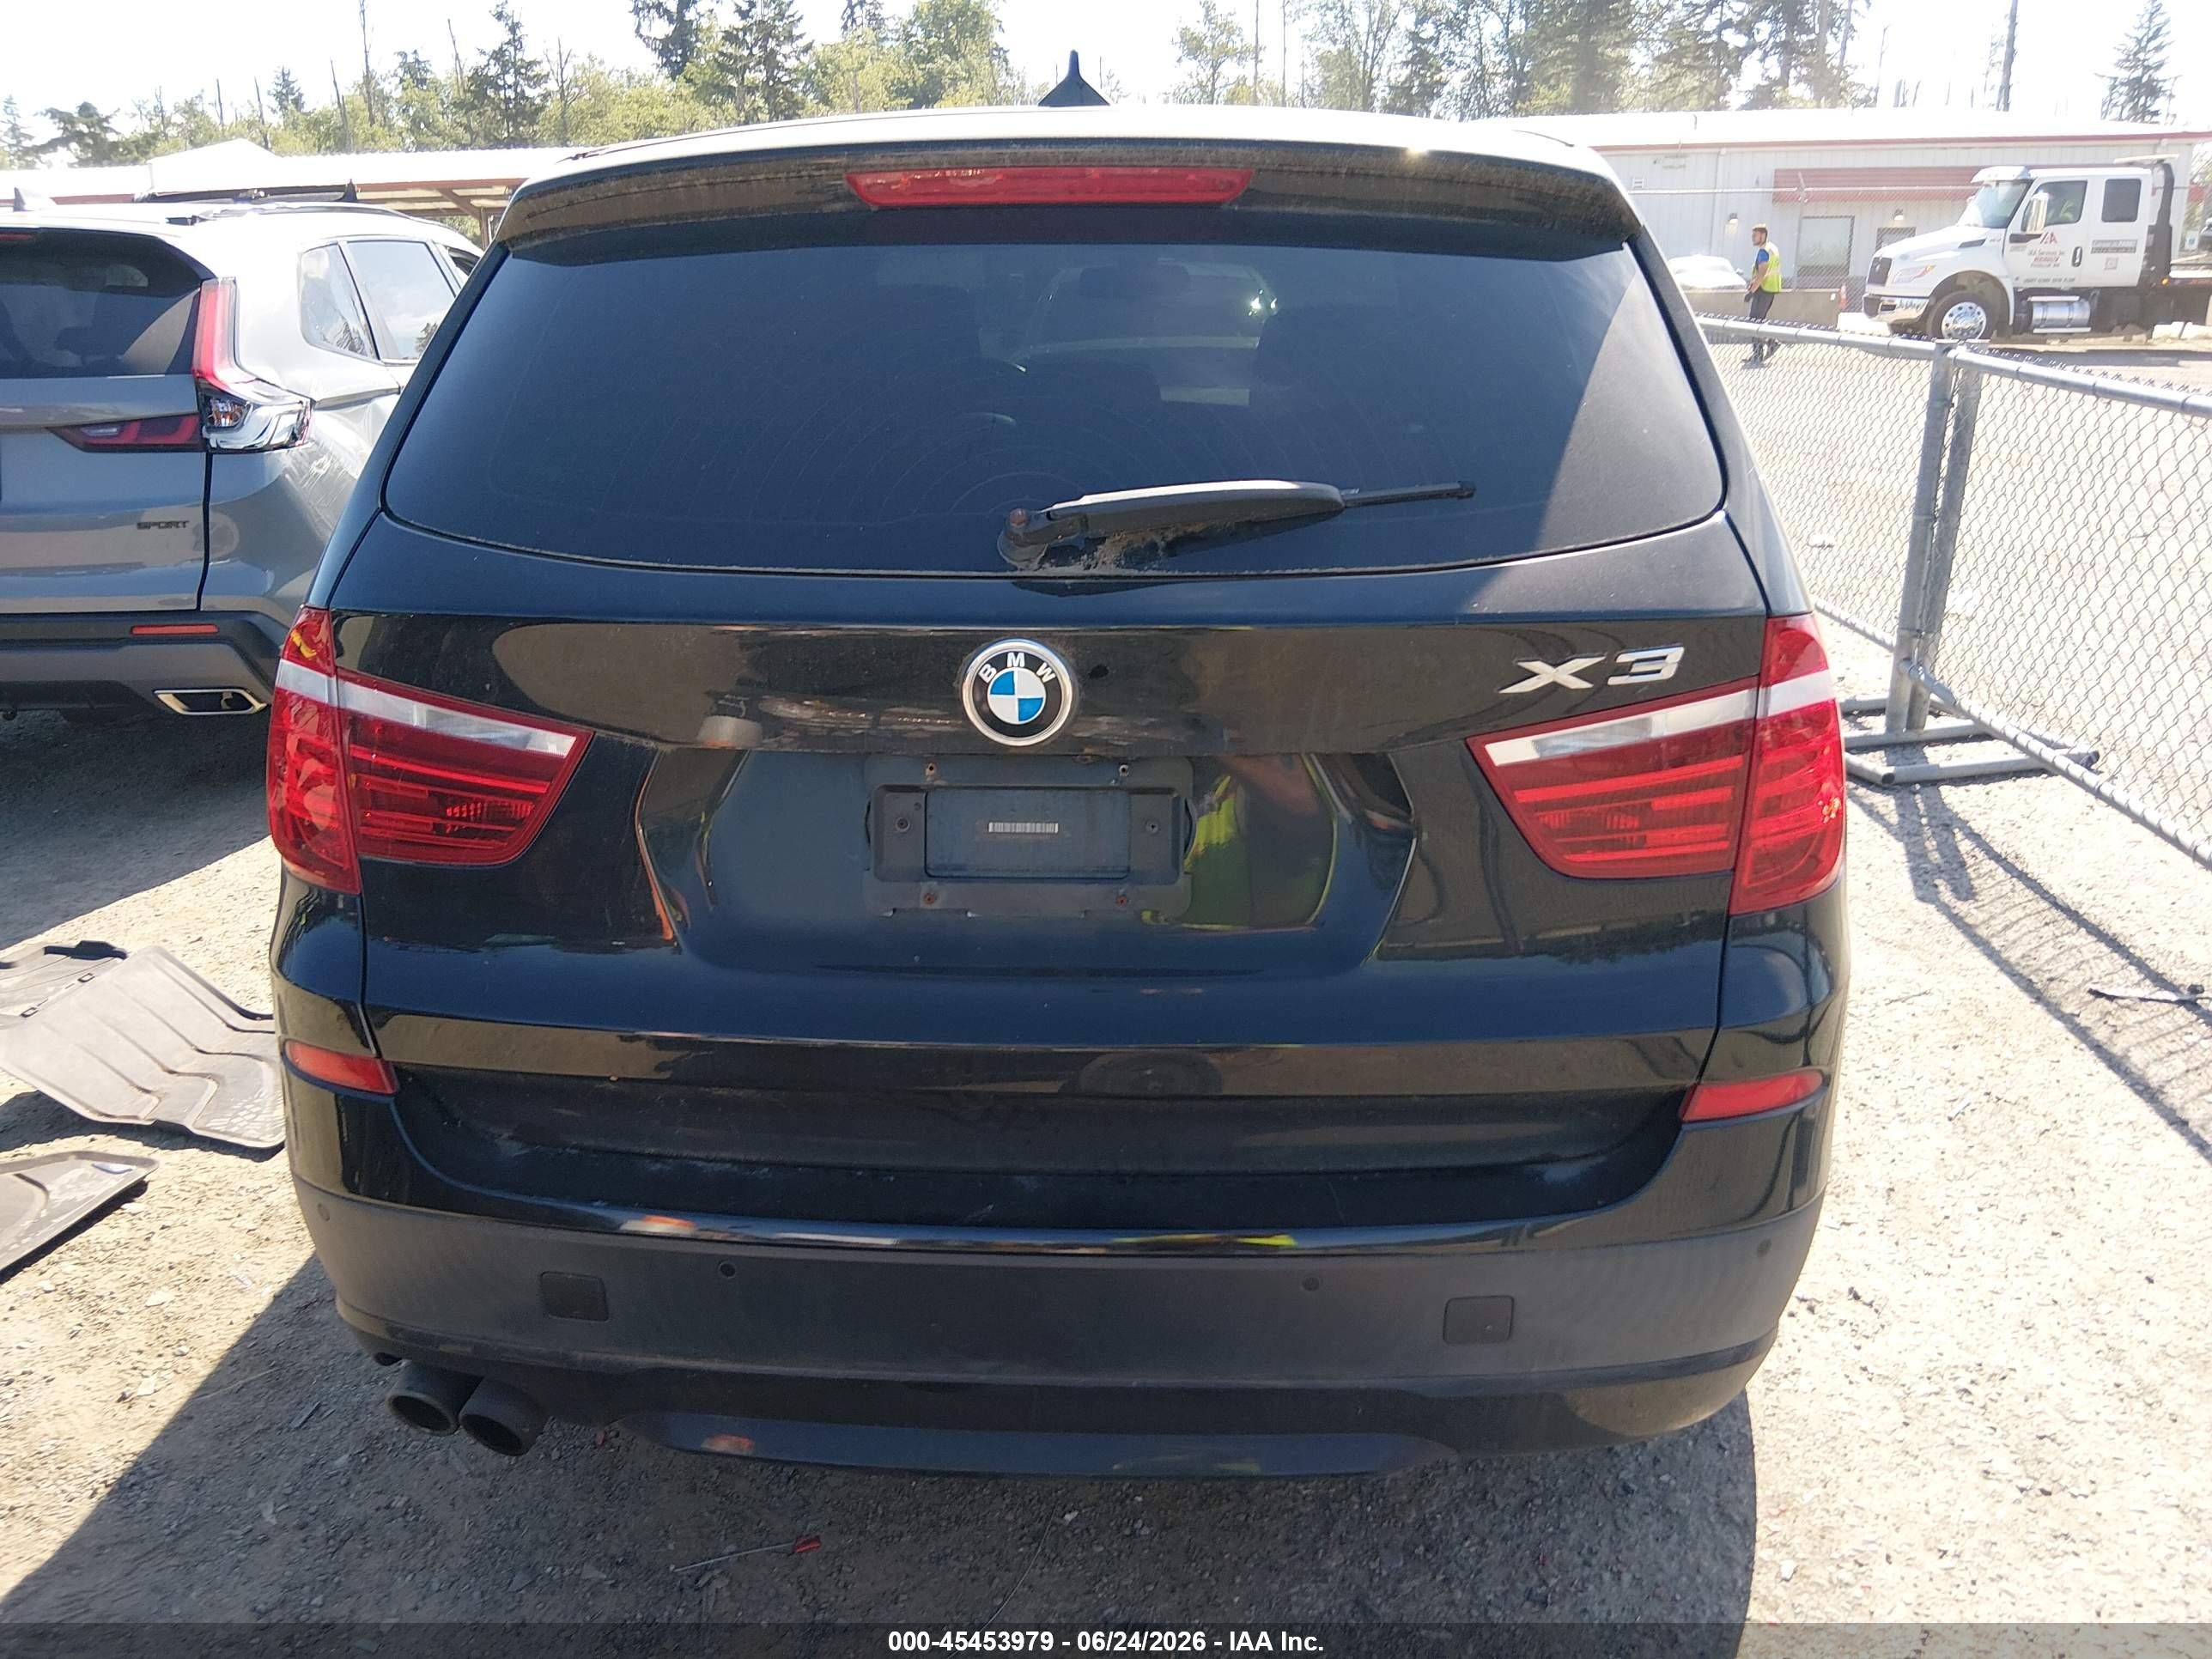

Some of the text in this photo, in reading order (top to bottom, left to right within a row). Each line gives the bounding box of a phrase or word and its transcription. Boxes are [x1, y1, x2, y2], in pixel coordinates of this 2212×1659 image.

[137, 520, 189, 530] SPORT
[978, 652, 1057, 684] BMW
[1498, 646, 1685, 694] X3
